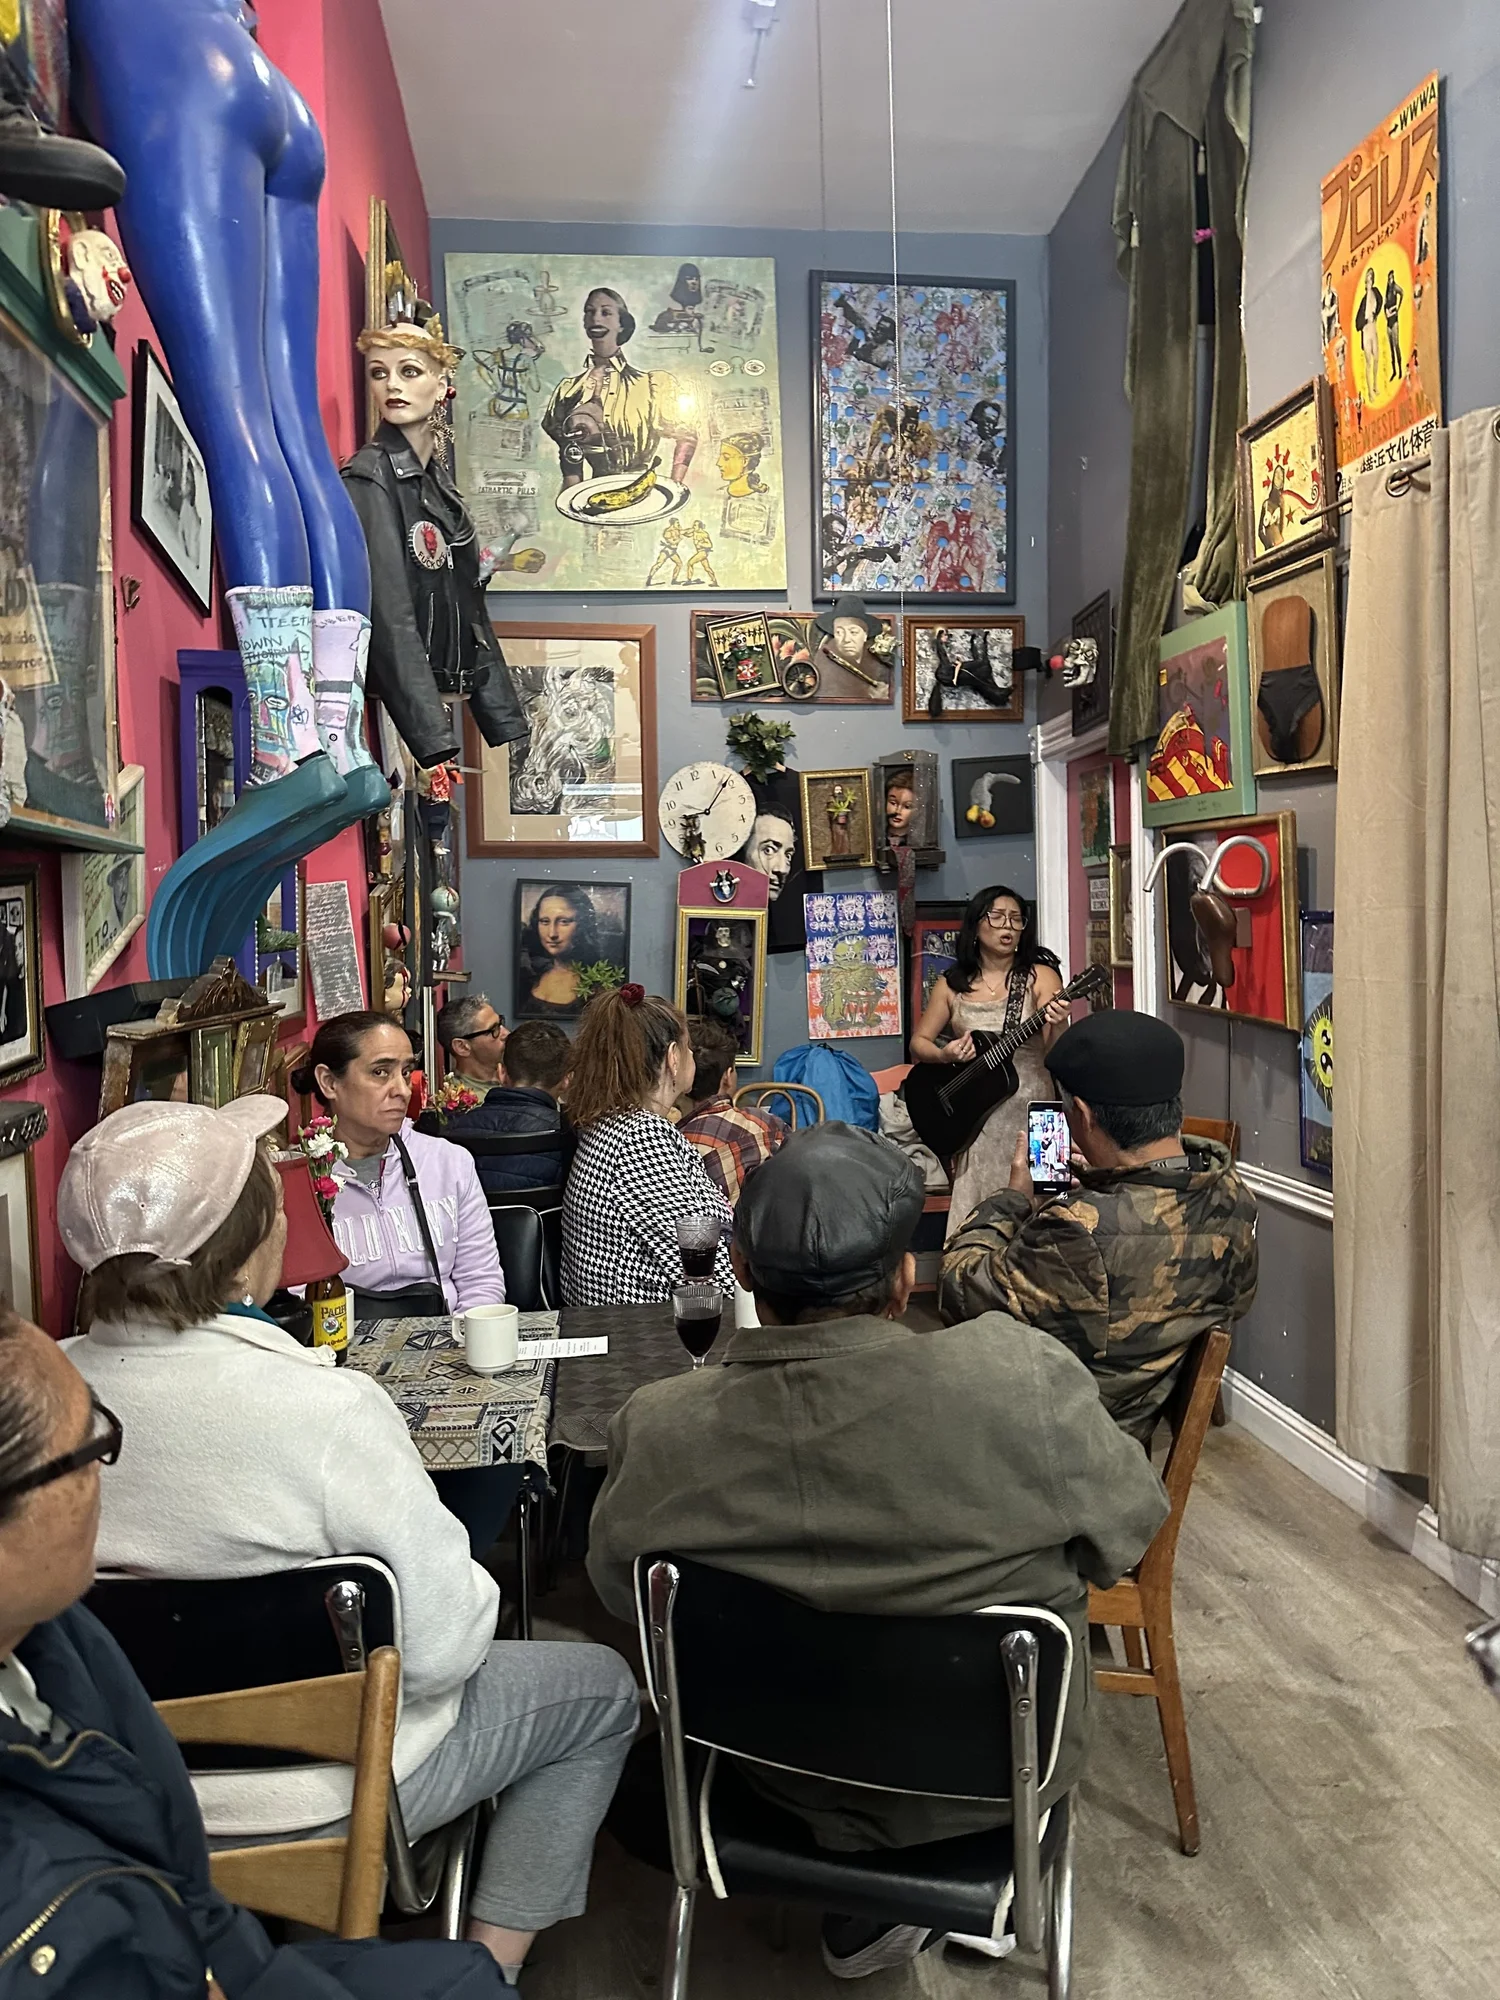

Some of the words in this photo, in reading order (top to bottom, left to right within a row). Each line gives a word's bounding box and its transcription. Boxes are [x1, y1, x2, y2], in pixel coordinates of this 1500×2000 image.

[1399, 82, 1436, 131] WWWA
[1322, 109, 1438, 276] プロレス
[1360, 416, 1440, 474] 横浜文化体育
[516, 487, 536, 496] PILLS
[690, 770, 700, 781] 12
[675, 781, 683, 791] 11
[666, 800, 676, 811] 10
[738, 795, 746, 805] 3
[668, 819, 676, 829] 9
[738, 814, 746, 823] 4
[731, 832, 739, 843] 5
[715, 842, 723, 853] 6
